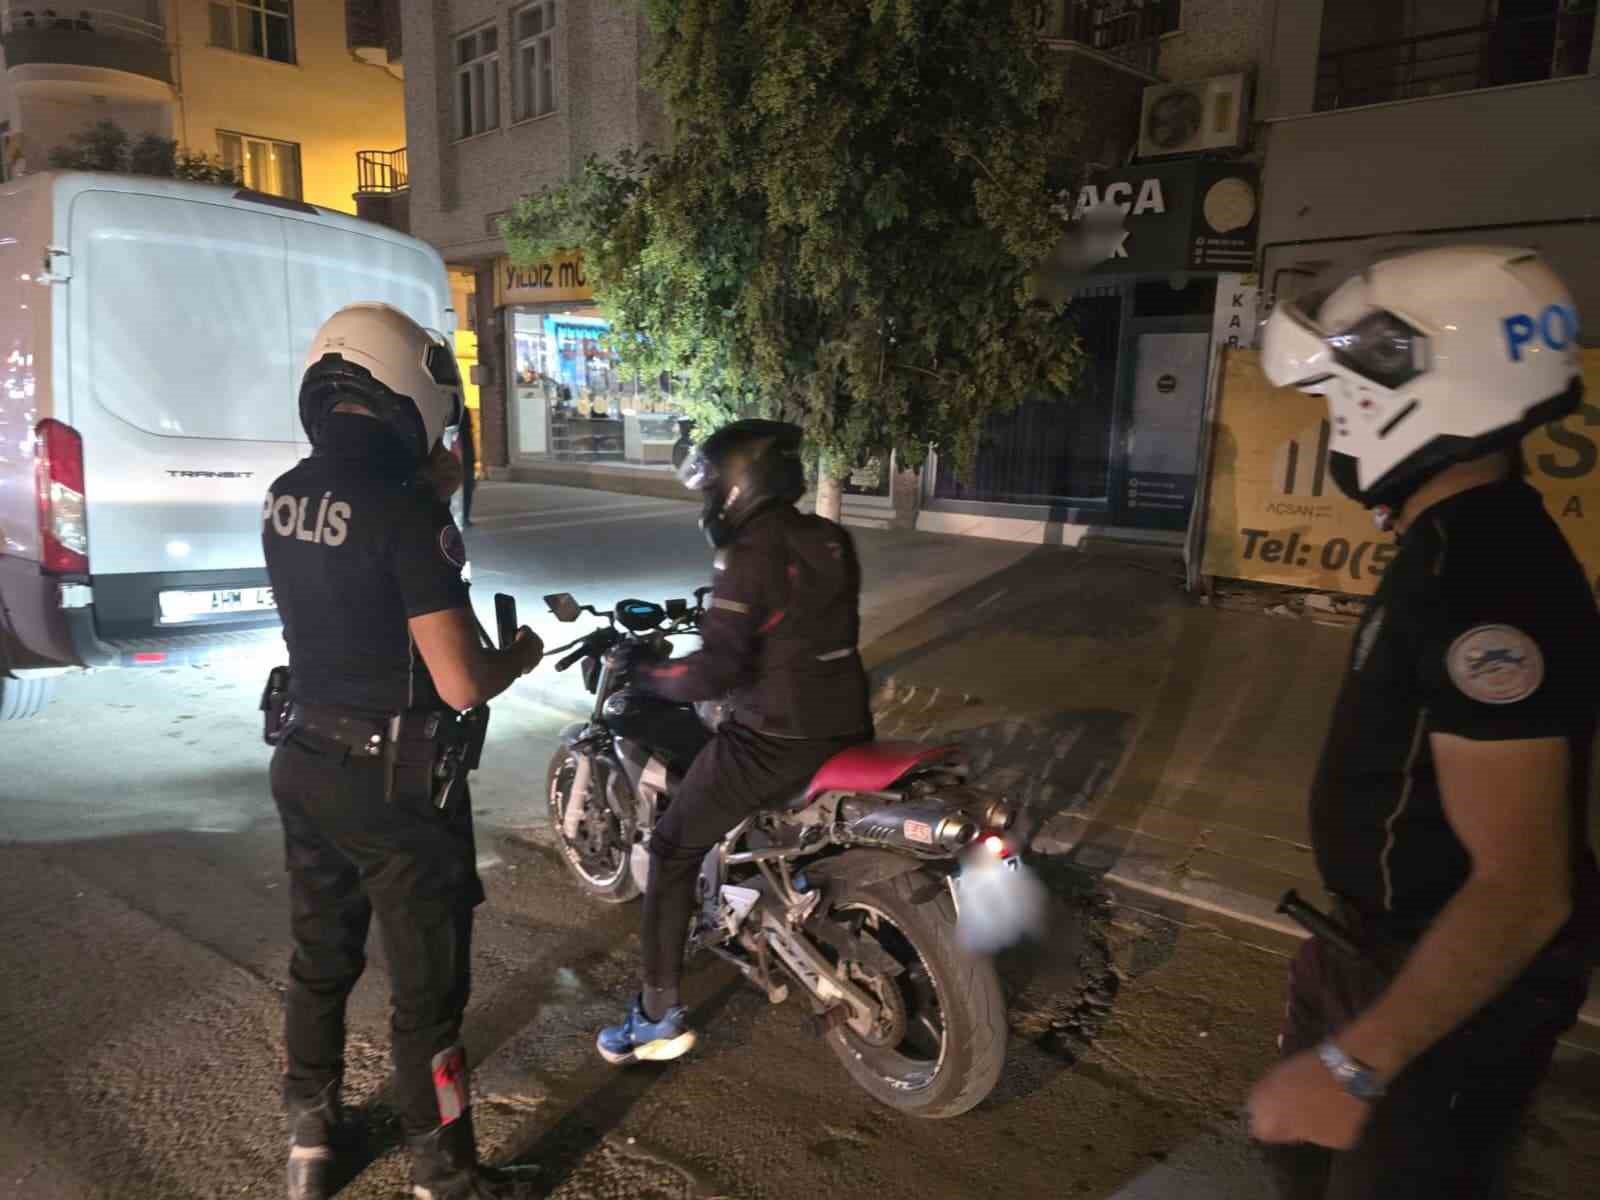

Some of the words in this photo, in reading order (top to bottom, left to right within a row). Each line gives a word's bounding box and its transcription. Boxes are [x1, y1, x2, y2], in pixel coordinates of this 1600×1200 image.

[166, 470, 255, 478] TRANSIT
[263, 491, 352, 547] POLİS
[1241, 528, 1312, 566] Tel:
